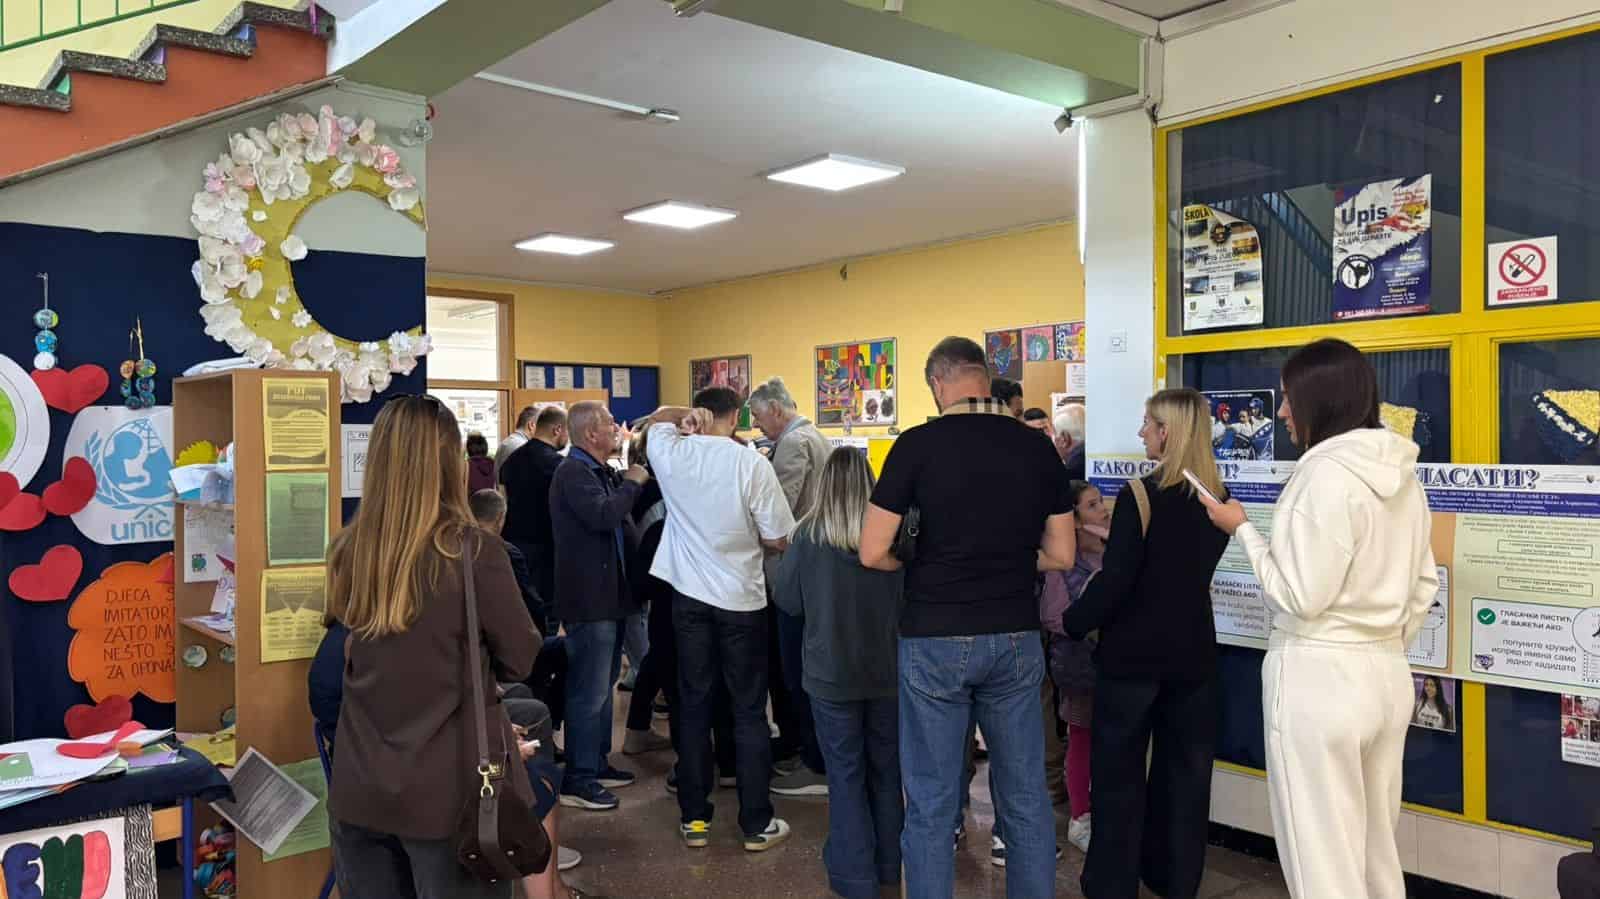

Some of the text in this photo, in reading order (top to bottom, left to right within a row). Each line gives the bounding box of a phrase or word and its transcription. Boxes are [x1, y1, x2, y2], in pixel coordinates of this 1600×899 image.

[1341, 204, 1388, 227] Upis
[1093, 460, 1136, 476] KAKO
[1417, 467, 1540, 489] ЛАСАТИ?
[105, 588, 151, 604] DJECA
[1500, 609, 1539, 619] ГЛАСАЧКИ
[1511, 620, 1544, 629] ВАЖЕЋИ
[104, 624, 148, 643] ZATO
[105, 664, 125, 680] ZA
